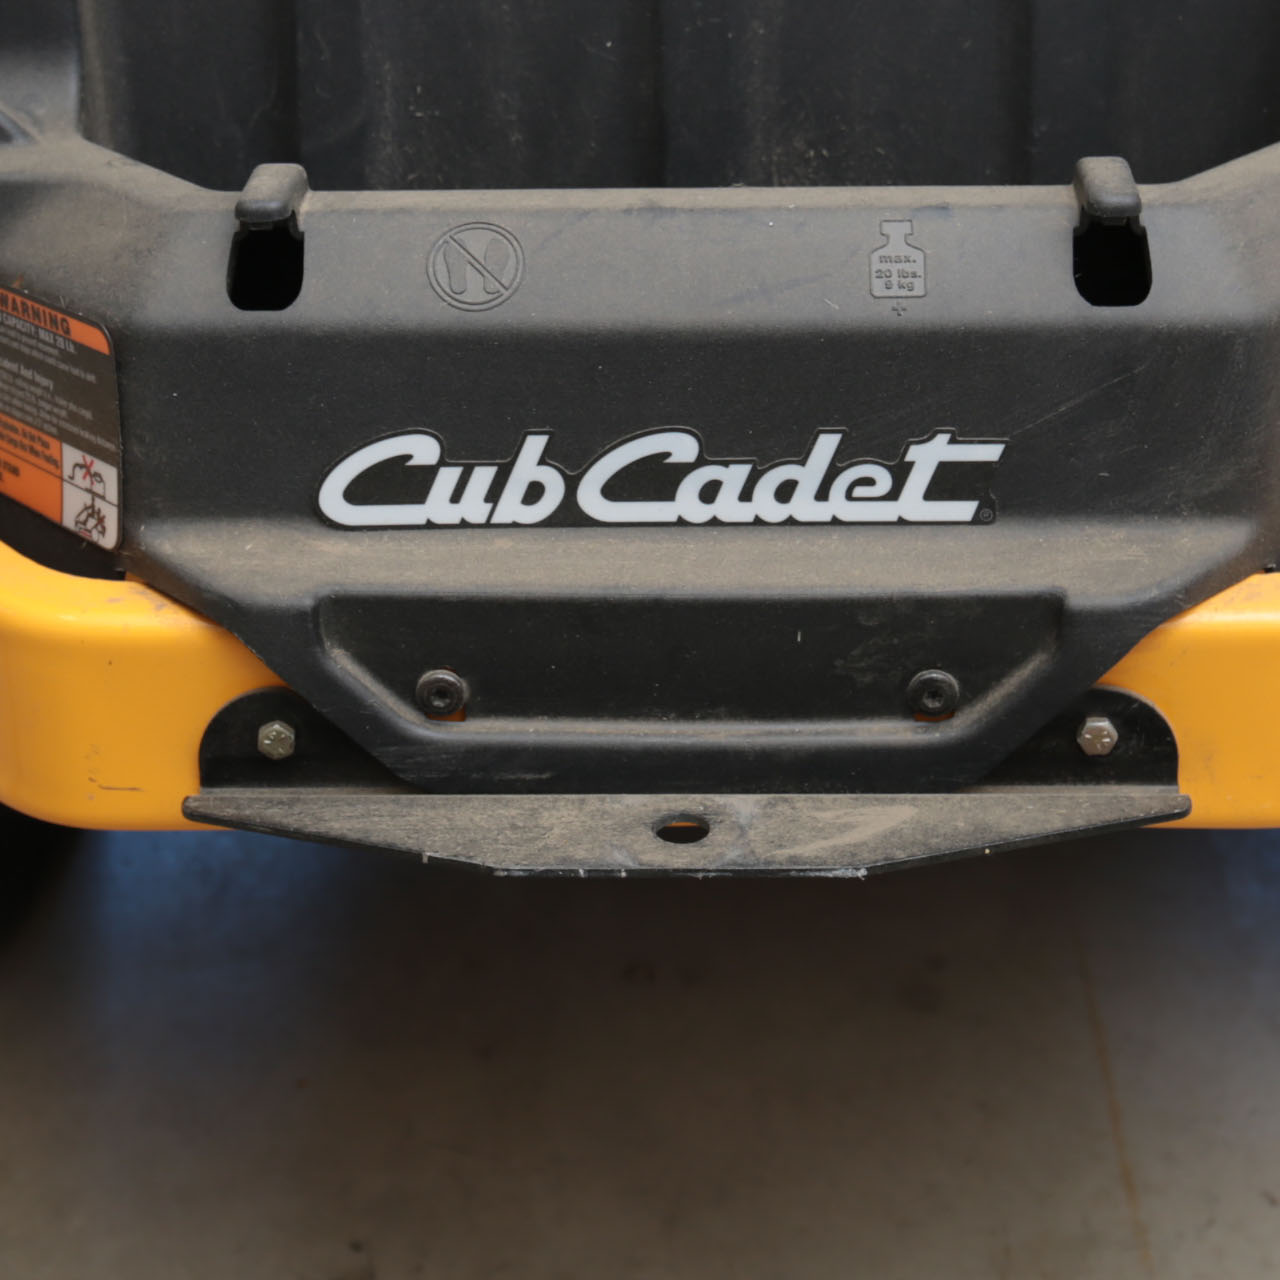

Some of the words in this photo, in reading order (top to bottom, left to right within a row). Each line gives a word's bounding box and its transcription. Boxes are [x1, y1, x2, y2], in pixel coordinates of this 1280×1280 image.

[879, 255, 917, 263] max.
[874, 269, 892, 279] 20
[897, 269, 922, 279] lbs.
[897, 280, 915, 292] kg
[317, 432, 565, 527] Cub
[576, 431, 1009, 525] Cadet
